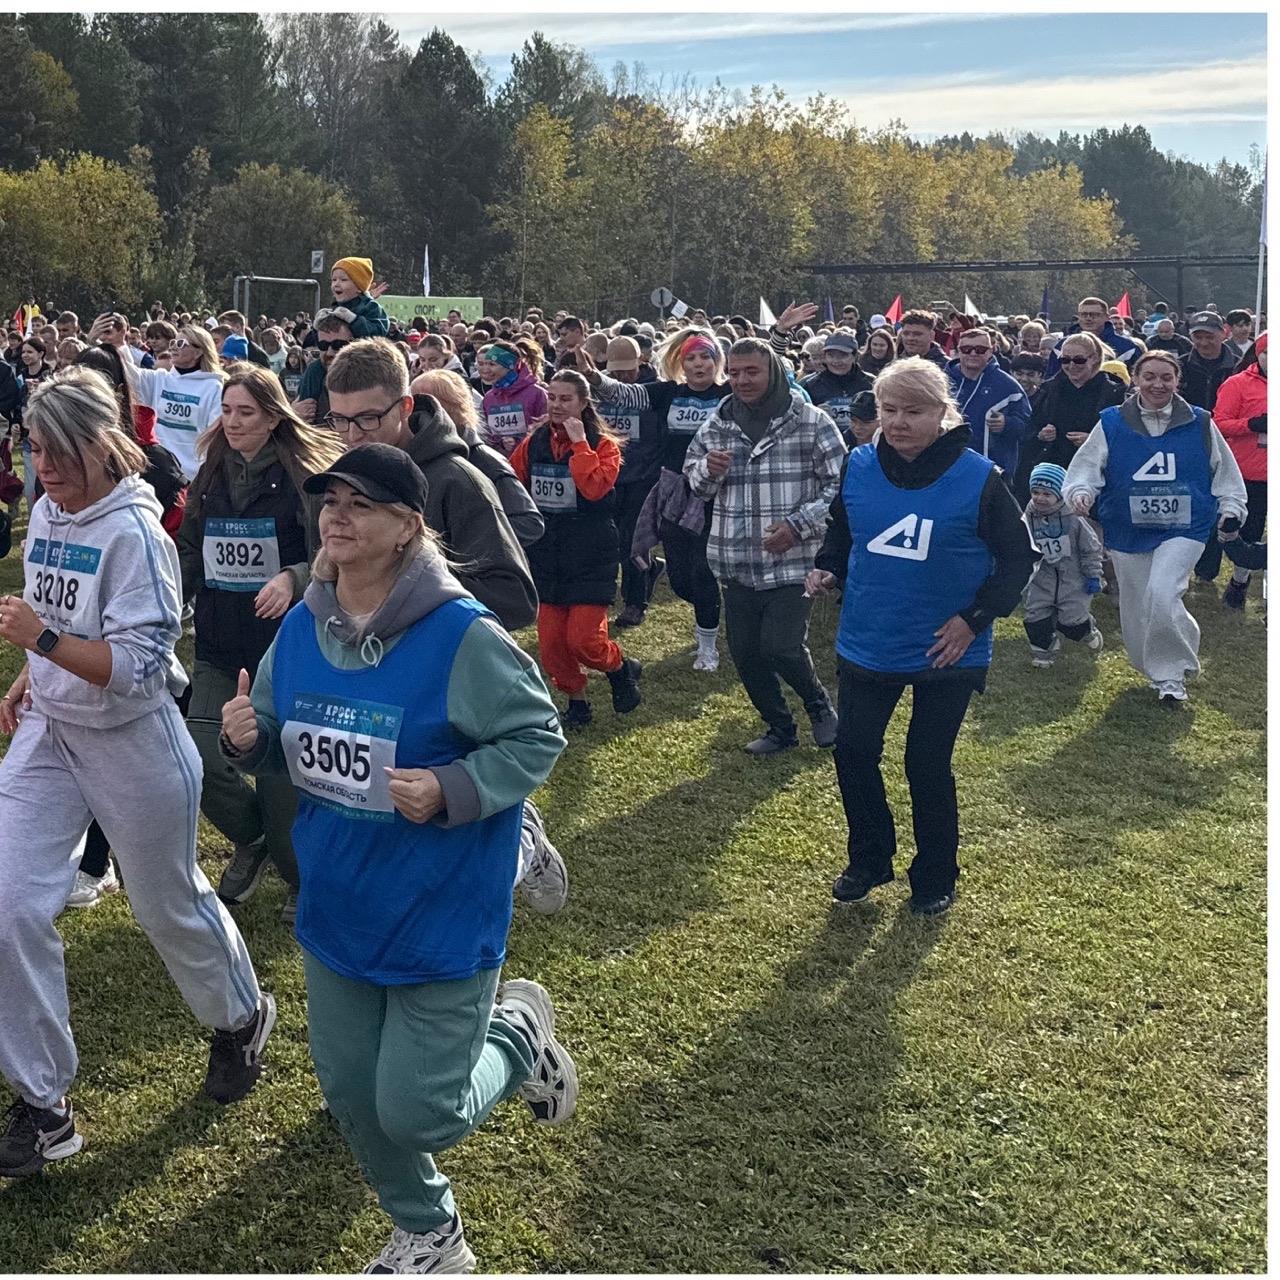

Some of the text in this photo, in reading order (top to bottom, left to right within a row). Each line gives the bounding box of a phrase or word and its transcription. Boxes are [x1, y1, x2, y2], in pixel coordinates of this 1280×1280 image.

[164, 402, 192, 418] 3930
[676, 409, 708, 422] 3402
[494, 414, 518, 428] 3844
[535, 479, 565, 497] 3679
[1140, 498, 1179, 515] 3530
[215, 541, 265, 567] 3892
[33, 570, 80, 611] 3208
[323, 715, 356, 726] НАЦИИ
[325, 704, 358, 720] КРОСС
[298, 731, 371, 782] 3505
[304, 777, 335, 794] ТОМСКАЯ
